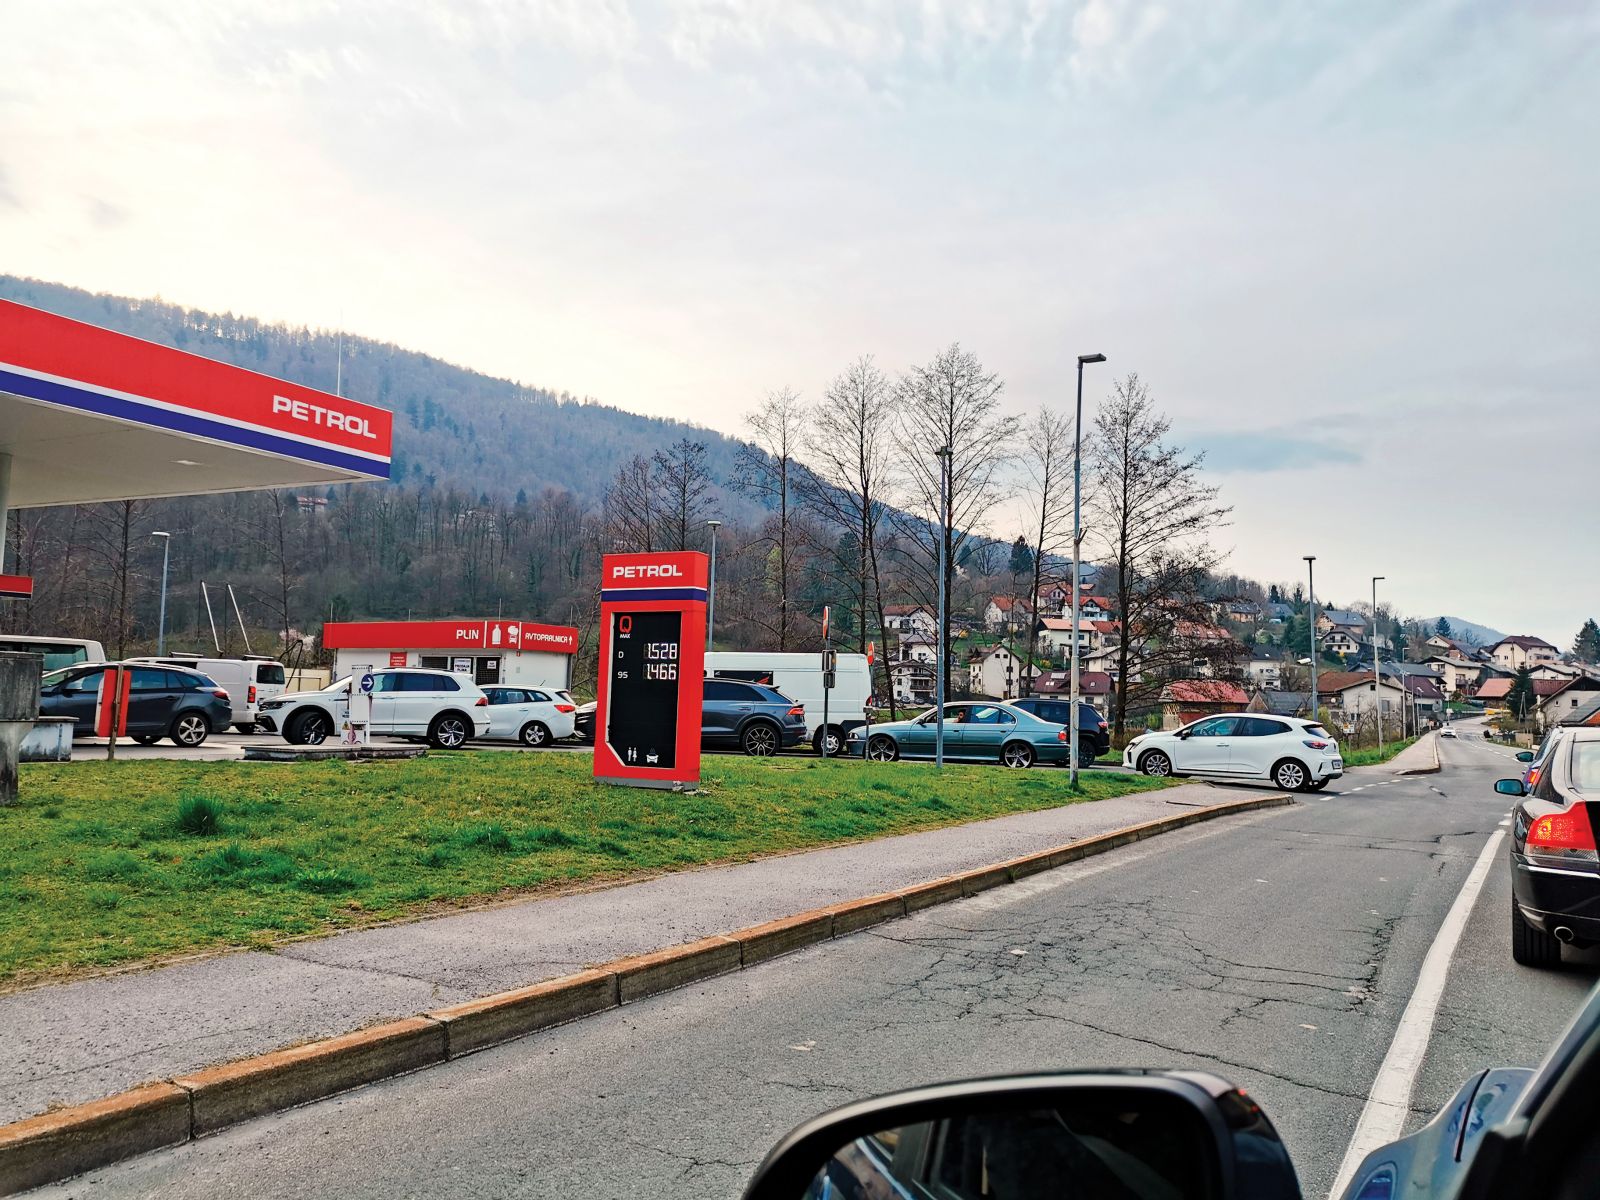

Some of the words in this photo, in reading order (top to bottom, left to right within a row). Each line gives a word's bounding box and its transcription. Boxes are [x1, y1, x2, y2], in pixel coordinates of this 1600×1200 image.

[272, 394, 377, 439] PETROL
[612, 565, 682, 578] PETROL
[620, 616, 632, 634] Q
[456, 629, 479, 640] PLIN
[525, 632, 568, 643] AVTOPRALNICA
